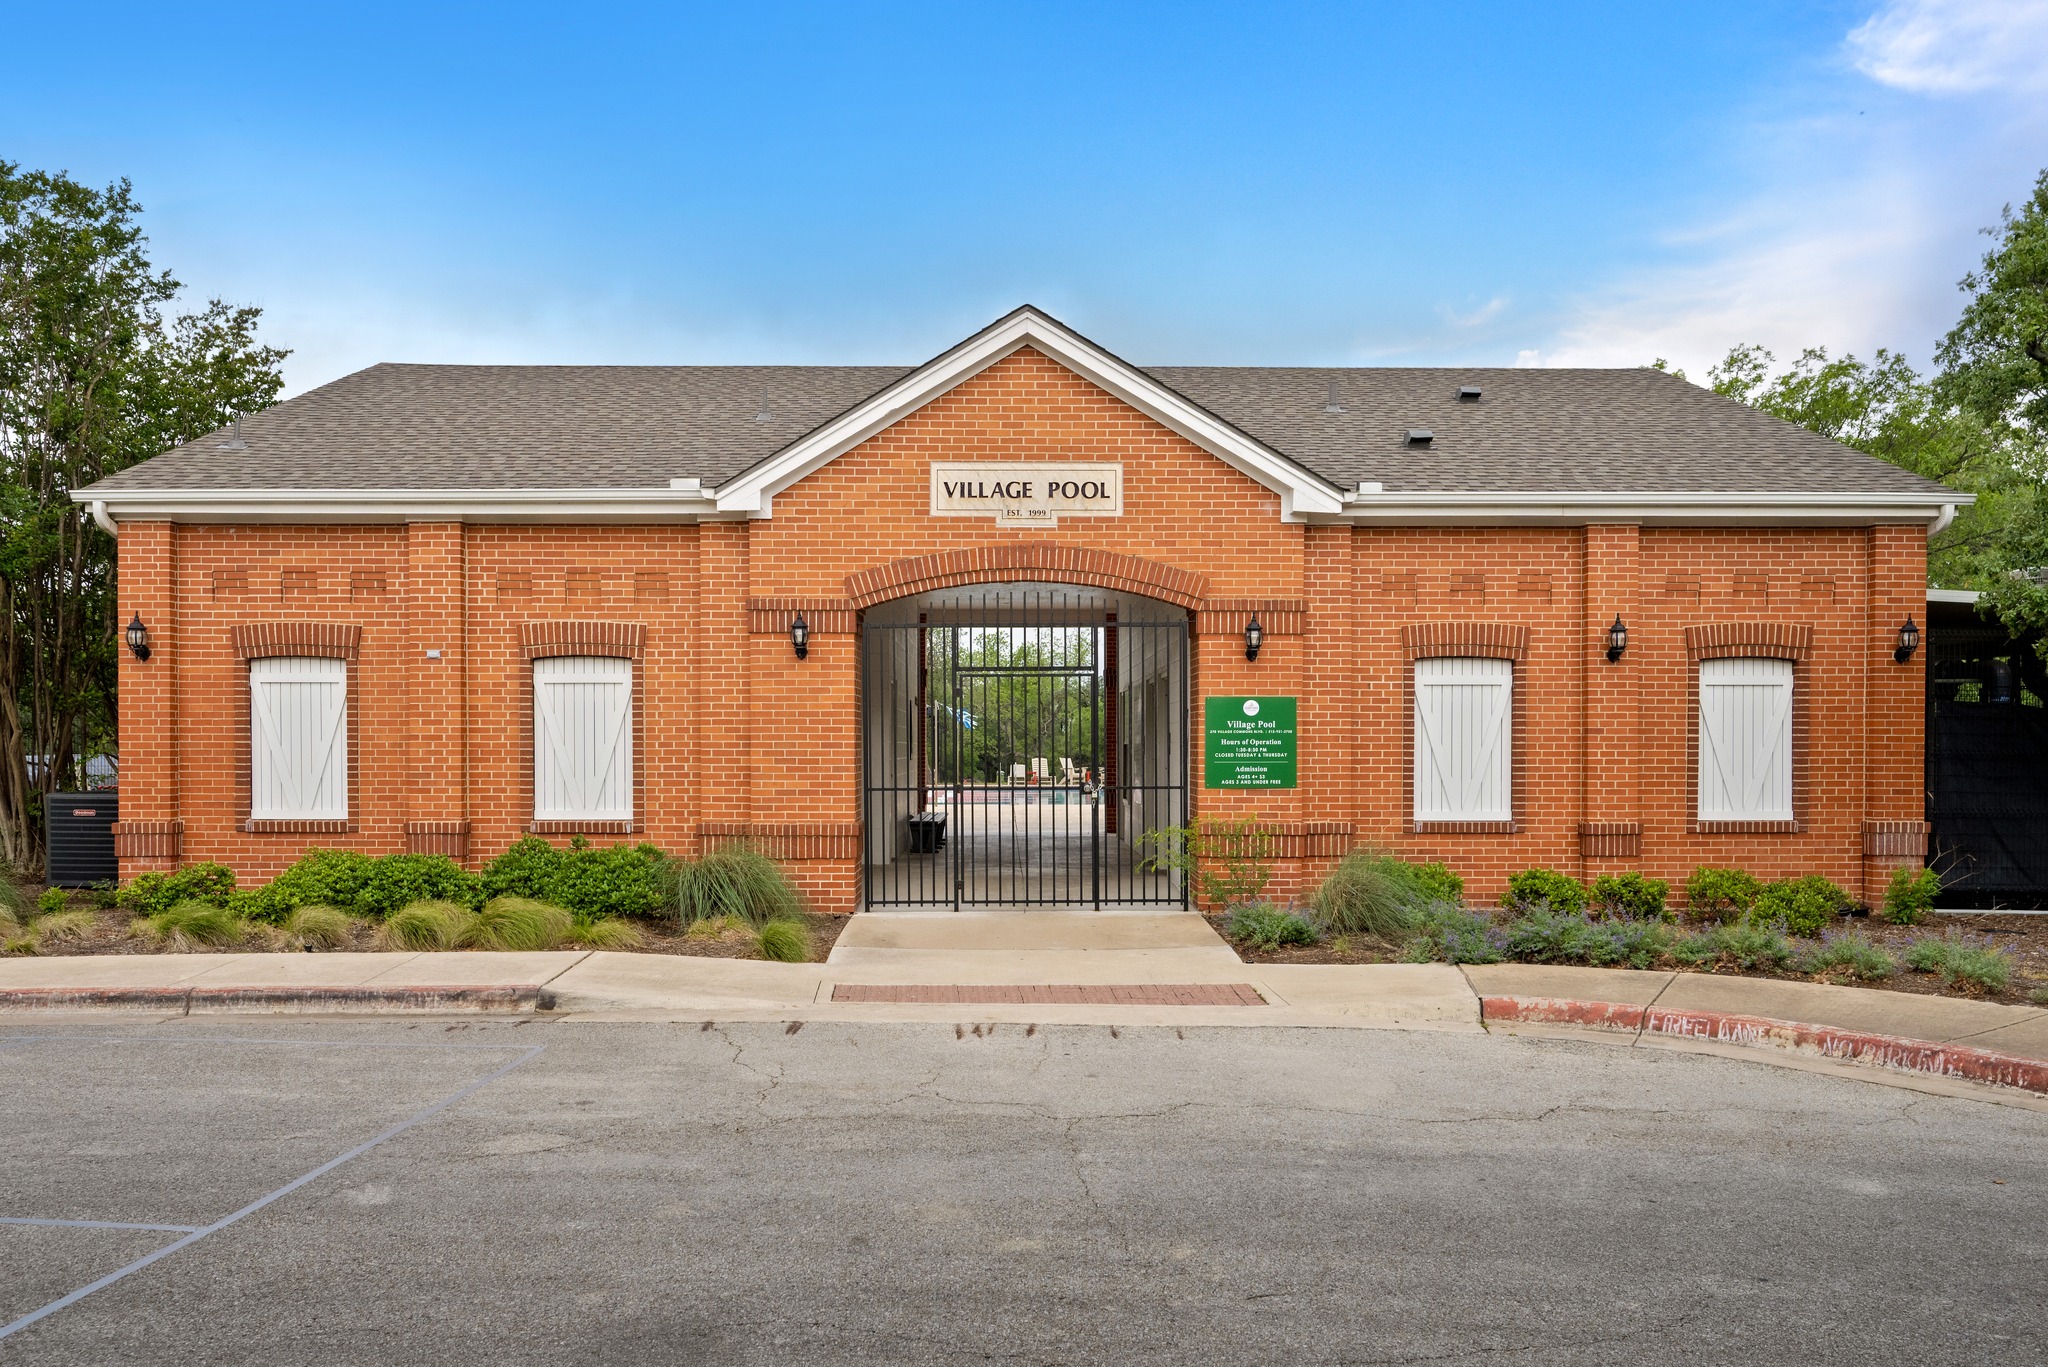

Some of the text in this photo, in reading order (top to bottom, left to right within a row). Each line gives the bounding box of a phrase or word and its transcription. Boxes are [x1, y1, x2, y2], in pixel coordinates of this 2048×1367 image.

[943, 481, 1110, 499] VILLAGE POOL
[1227, 721, 1255, 730] Village
